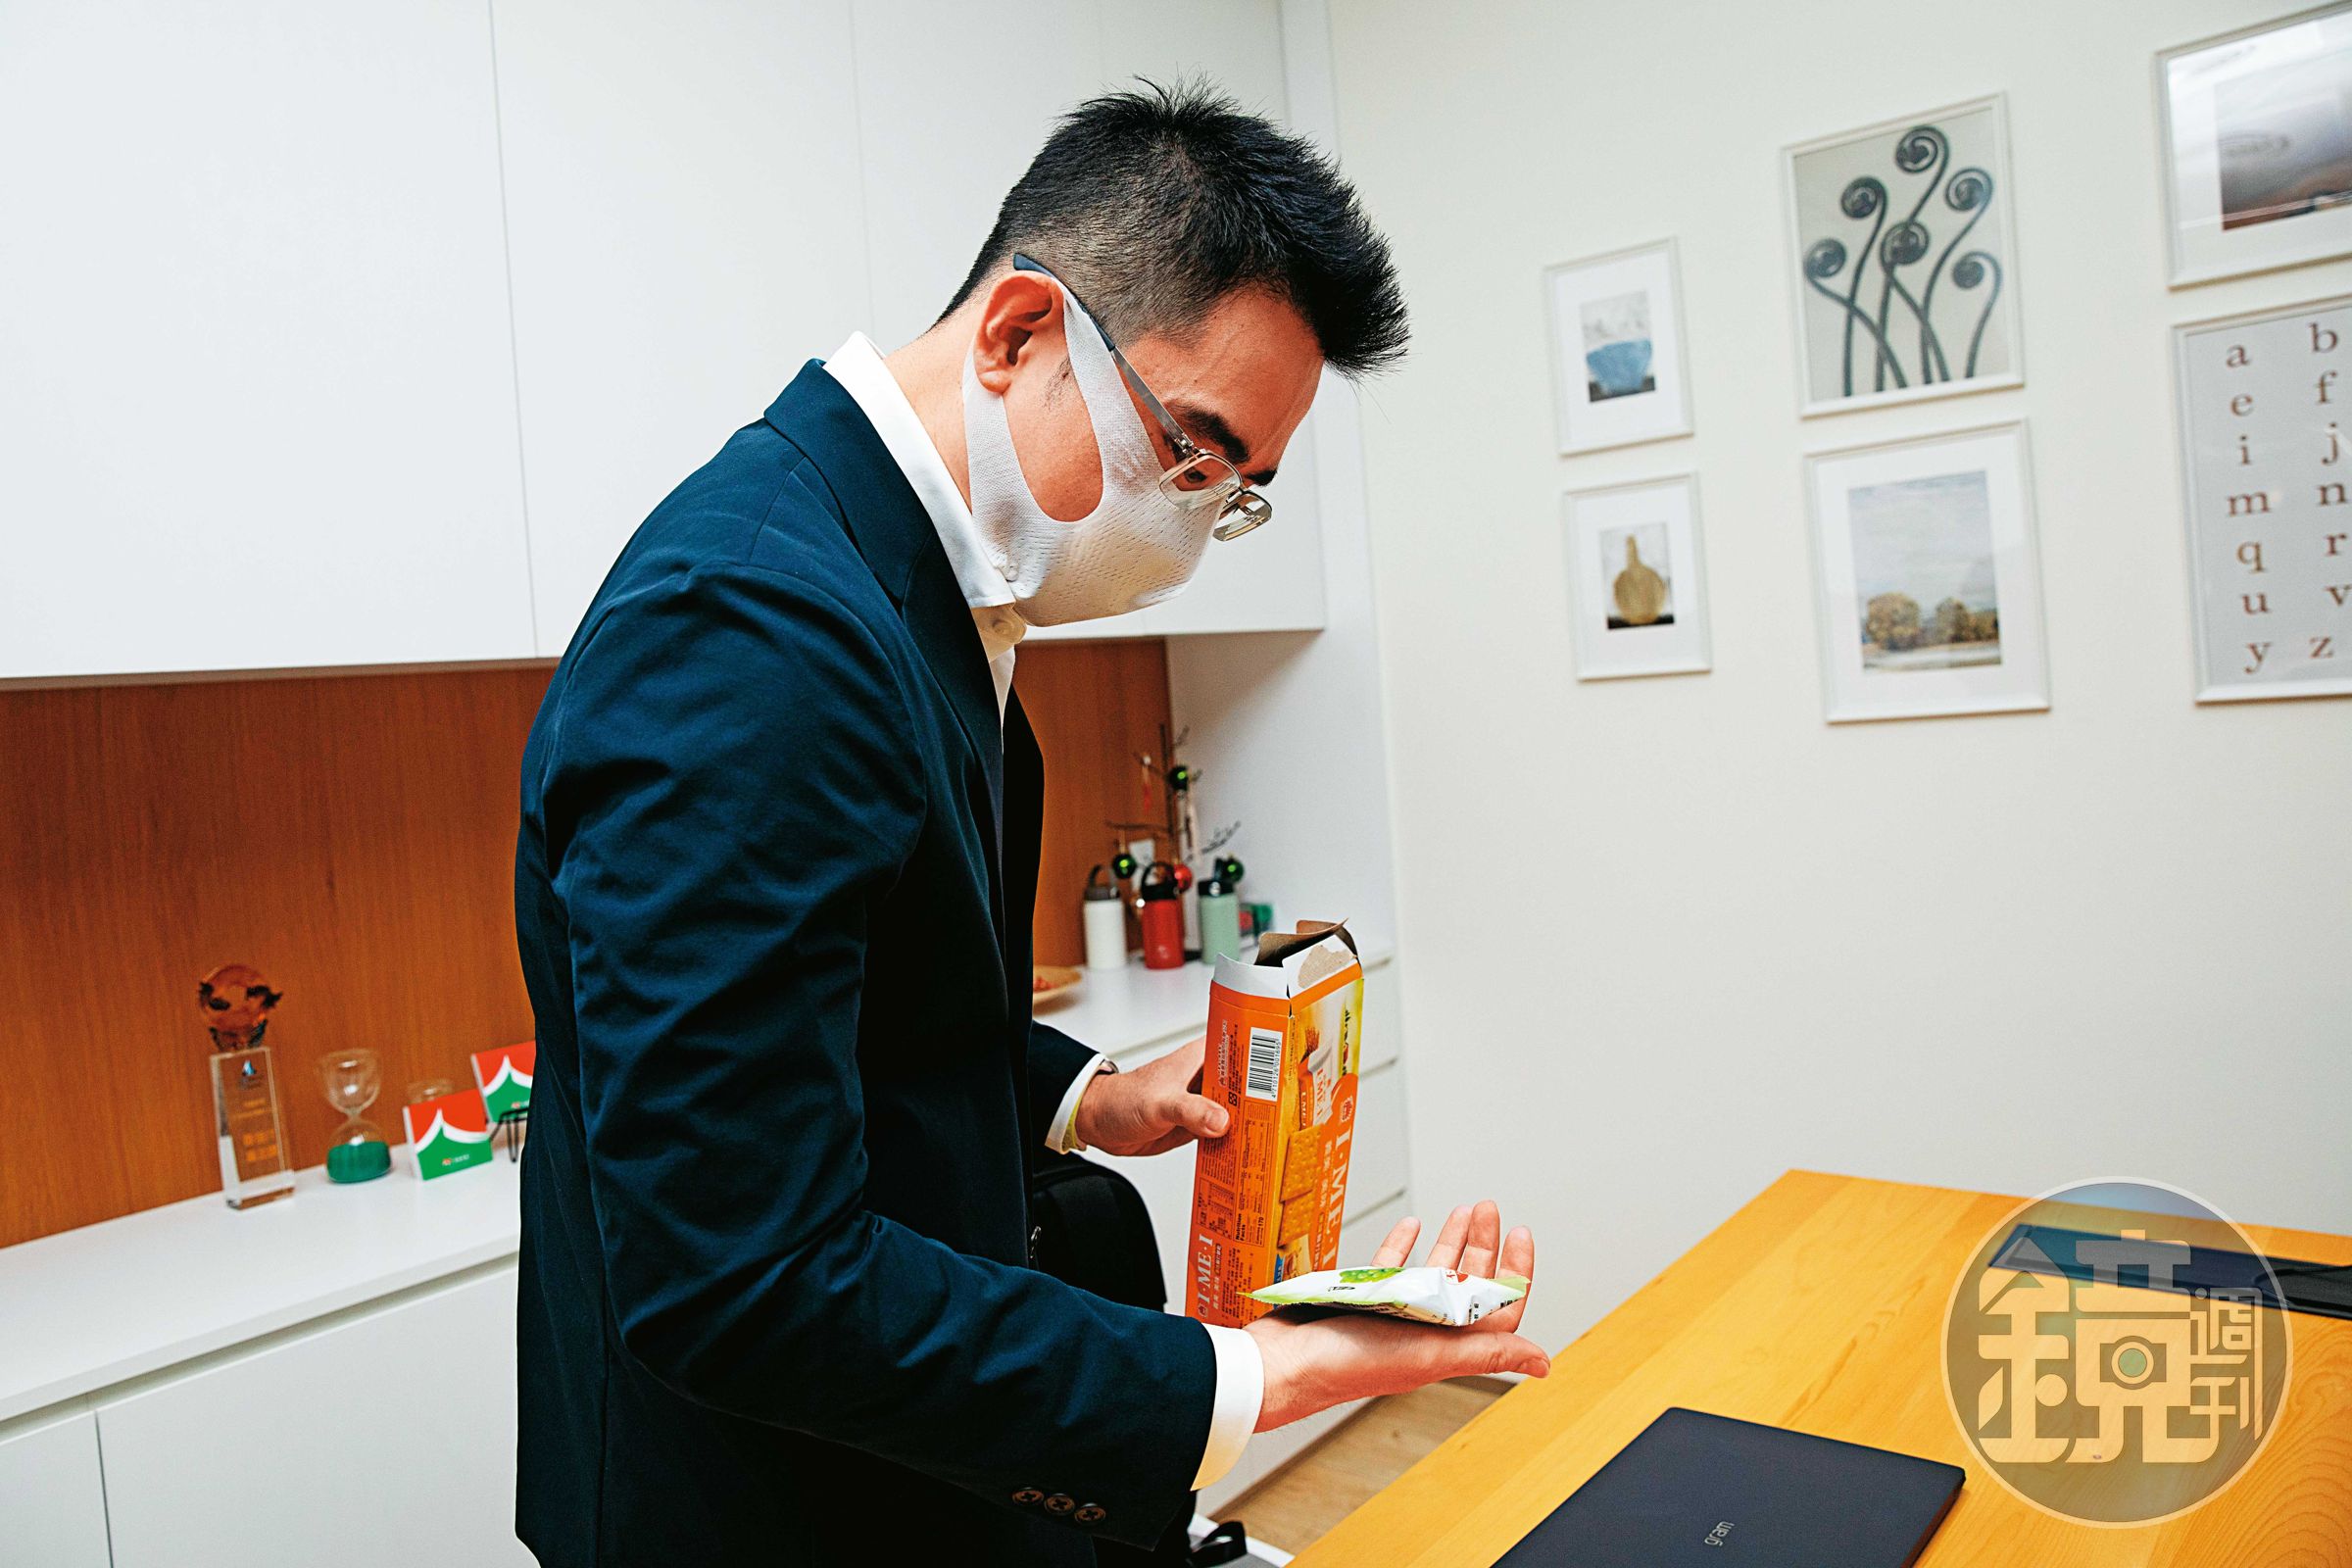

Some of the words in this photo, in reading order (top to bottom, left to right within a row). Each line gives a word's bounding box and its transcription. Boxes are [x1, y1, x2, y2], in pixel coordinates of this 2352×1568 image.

[2226, 344, 2250, 368] a
[2310, 322, 2338, 354] b
[2230, 393, 2253, 416] e
[2316, 371, 2338, 405] f
[2240, 435, 2252, 465] i
[2322, 422, 2338, 465] j
[2227, 491, 2271, 516] m
[2318, 481, 2348, 507] n
[2236, 541, 2266, 572] q
[2326, 533, 2347, 557] r
[2241, 593, 2271, 615] u
[2326, 584, 2352, 607] v
[2244, 642, 2271, 673] y
[2310, 637, 2333, 659] z
[1704, 1521, 1735, 1546] gram
